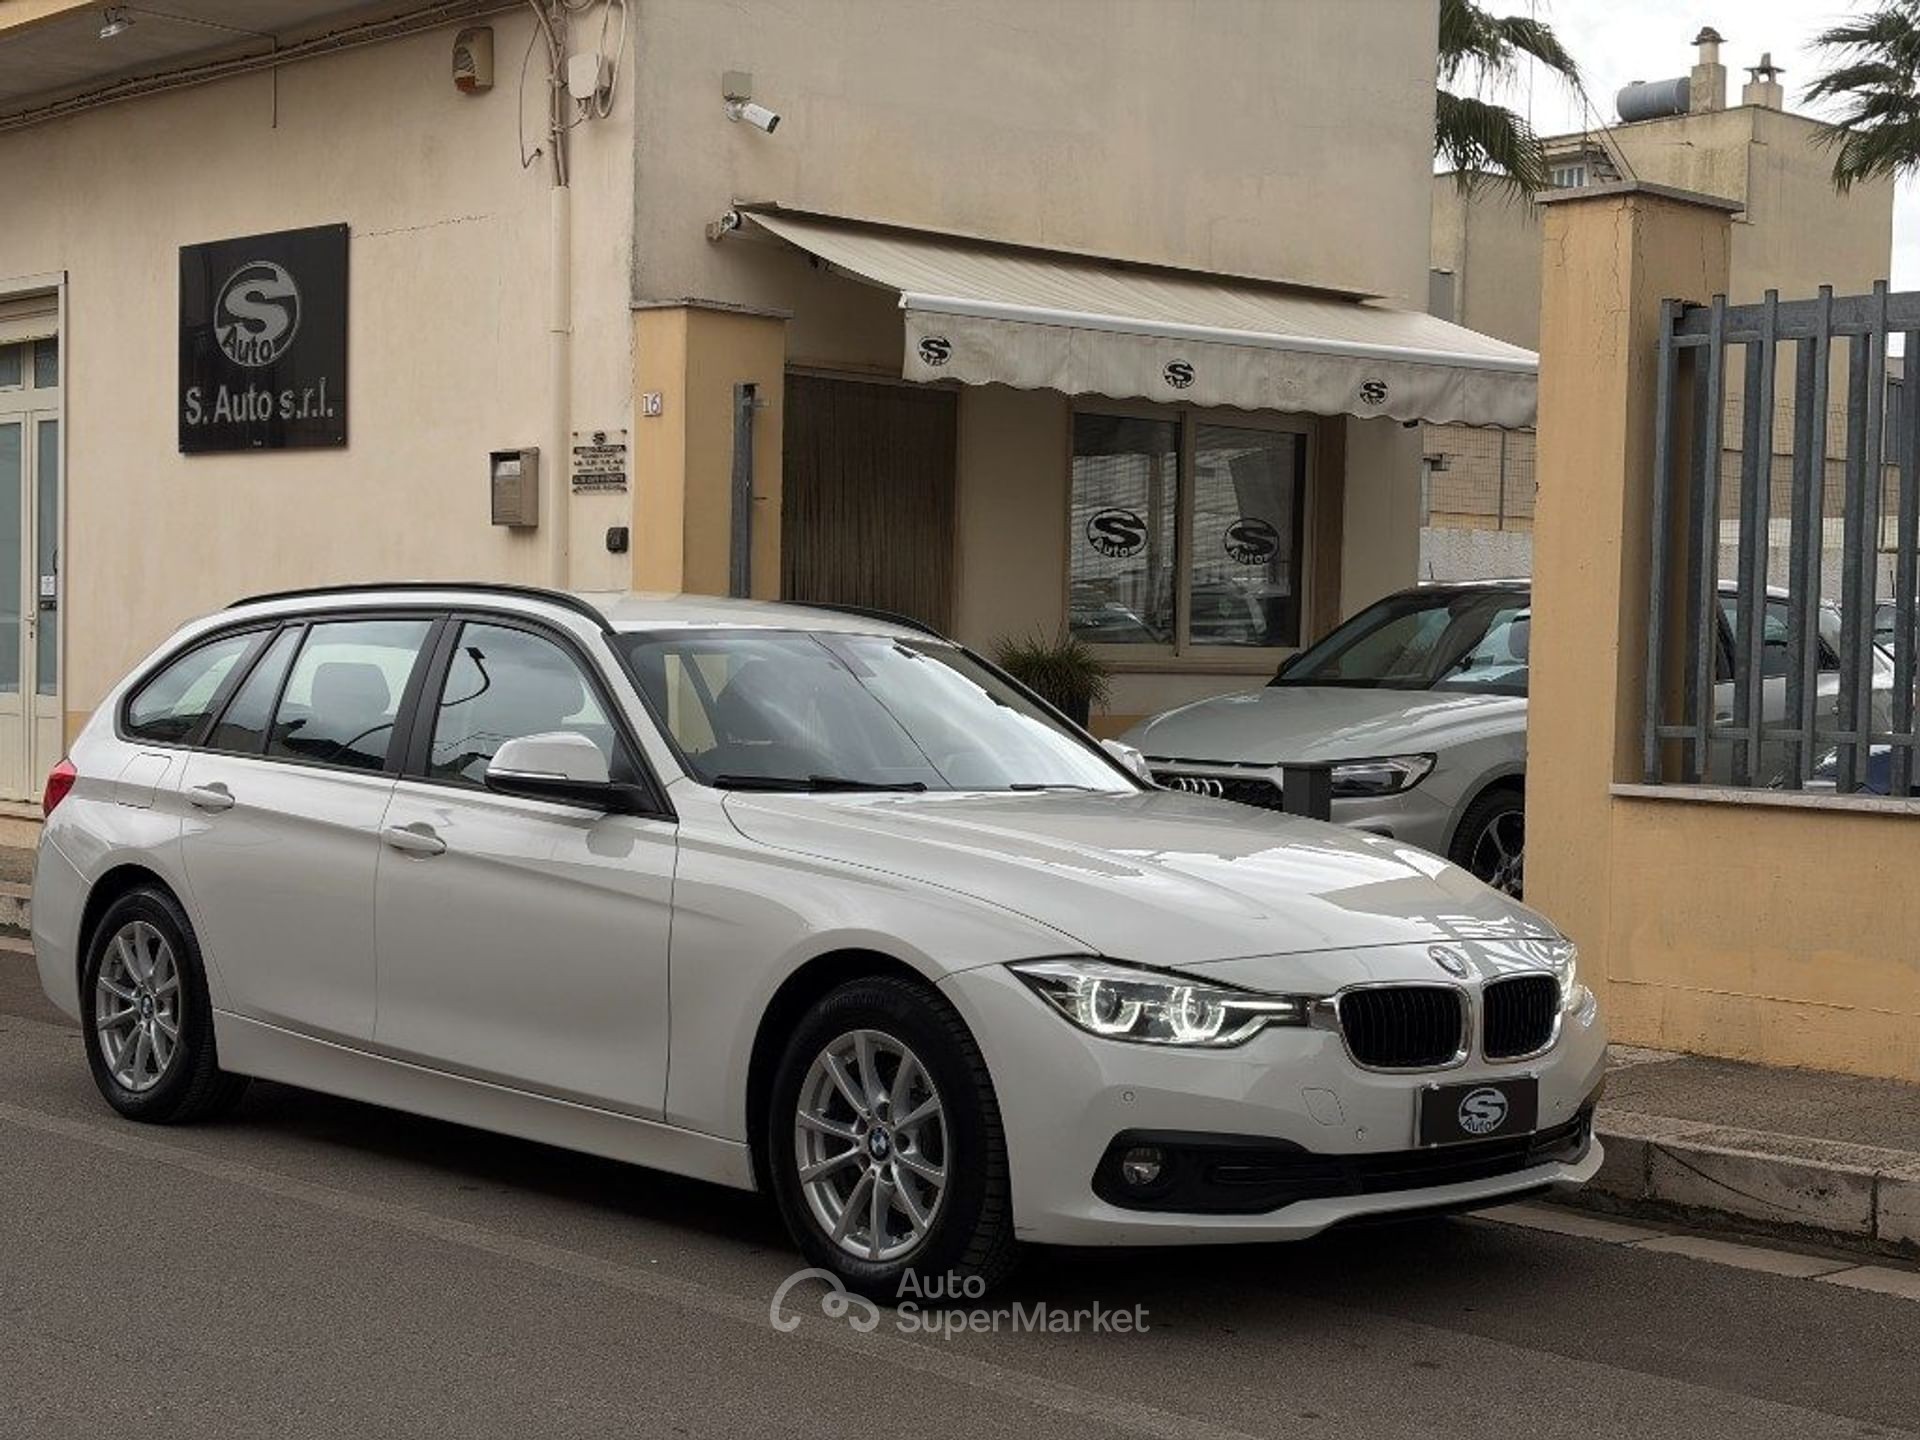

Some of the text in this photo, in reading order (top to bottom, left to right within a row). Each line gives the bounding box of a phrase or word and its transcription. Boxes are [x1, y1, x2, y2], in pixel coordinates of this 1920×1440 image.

[221, 323, 274, 364] Auto
[185, 386, 208, 425] S.
[213, 383, 273, 424] Auto
[643, 393, 660, 414] 16
[1094, 537, 1130, 557] Auto
[1462, 1116, 1493, 1132] Auto
